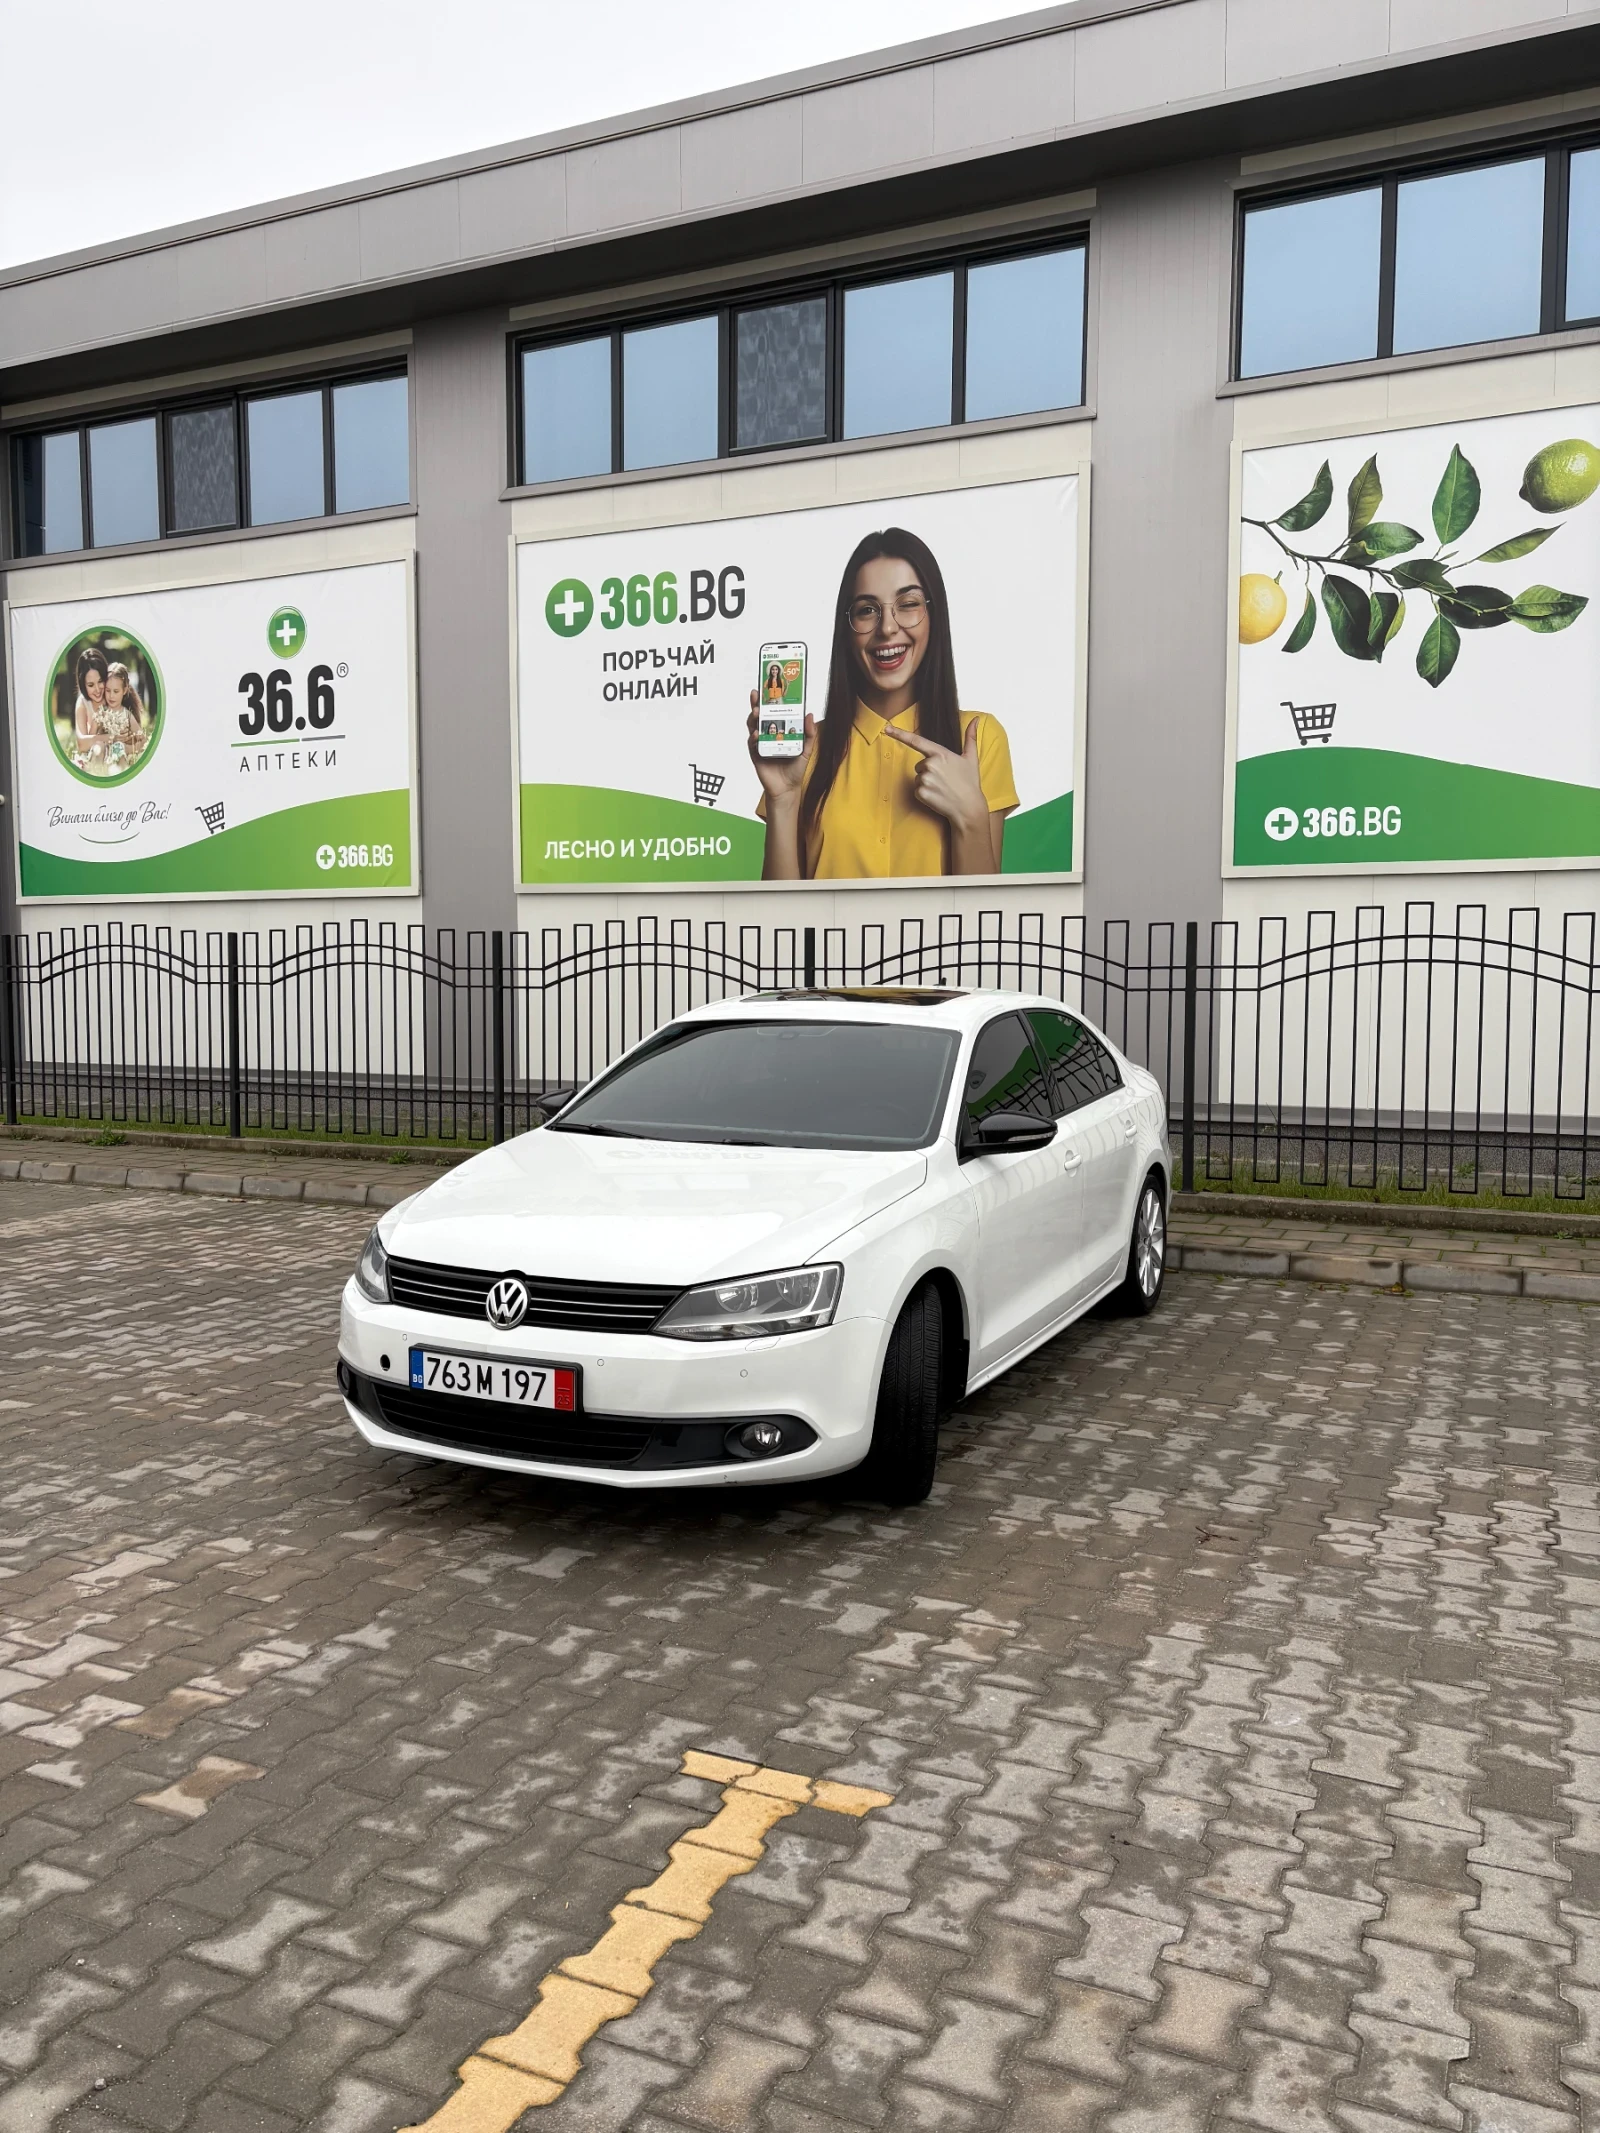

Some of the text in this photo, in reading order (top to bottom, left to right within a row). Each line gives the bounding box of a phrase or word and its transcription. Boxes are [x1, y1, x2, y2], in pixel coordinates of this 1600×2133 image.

[600, 565, 746, 630] 366.BG
[602, 638, 715, 672] ПОРЪЧАЙ
[238, 664, 335, 735] 36.6
[602, 672, 698, 702] ОНЛАЙН
[239, 749, 337, 773] АПТЕКИ
[47, 800, 172, 831] Винаги близо до Вас!
[1302, 805, 1402, 838] 366.BG
[337, 843, 394, 869] 366.BG
[544, 835, 732, 861] ЛЕСНО И УДОБНО
[412, 1373, 423, 1384] BG
[426, 1356, 472, 1392] 763
[501, 1368, 547, 1402] 197
